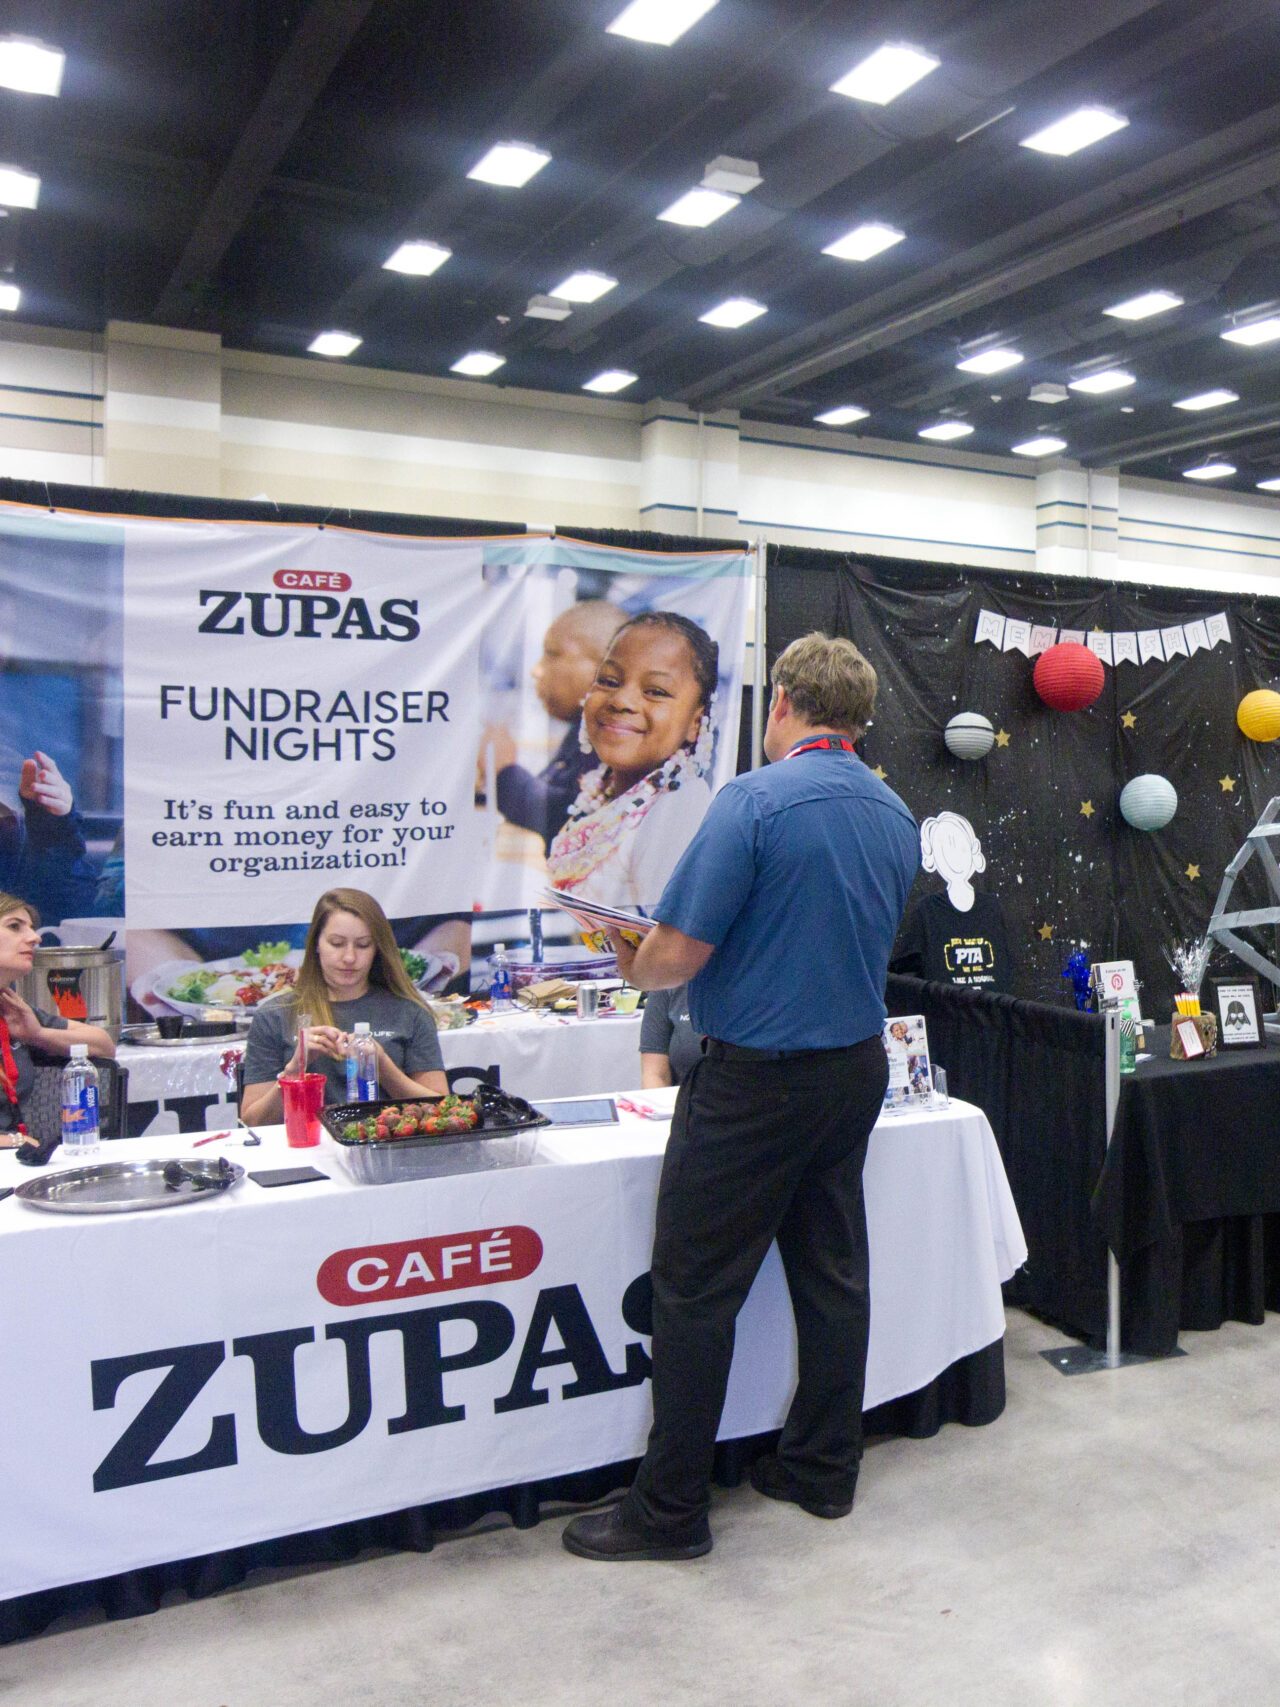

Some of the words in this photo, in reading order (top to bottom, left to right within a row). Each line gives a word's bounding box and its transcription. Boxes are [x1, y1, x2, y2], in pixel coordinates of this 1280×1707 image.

[282, 572, 342, 589] CAFÉ
[198, 590, 421, 642] ZUPAS
[160, 685, 450, 723] FUNDRAISER
[225, 727, 397, 762] NIGHTS
[163, 799, 213, 820] It's
[223, 800, 274, 820] fun
[285, 800, 340, 820] and
[350, 802, 410, 822] easy
[419, 797, 448, 816] to
[151, 831, 223, 847] earn
[234, 829, 333, 850] money
[342, 825, 384, 845] for
[391, 825, 455, 847] your
[208, 847, 407, 878] organization!
[955, 947, 984, 965] PTA
[345, 1230, 514, 1294] CAFÉ
